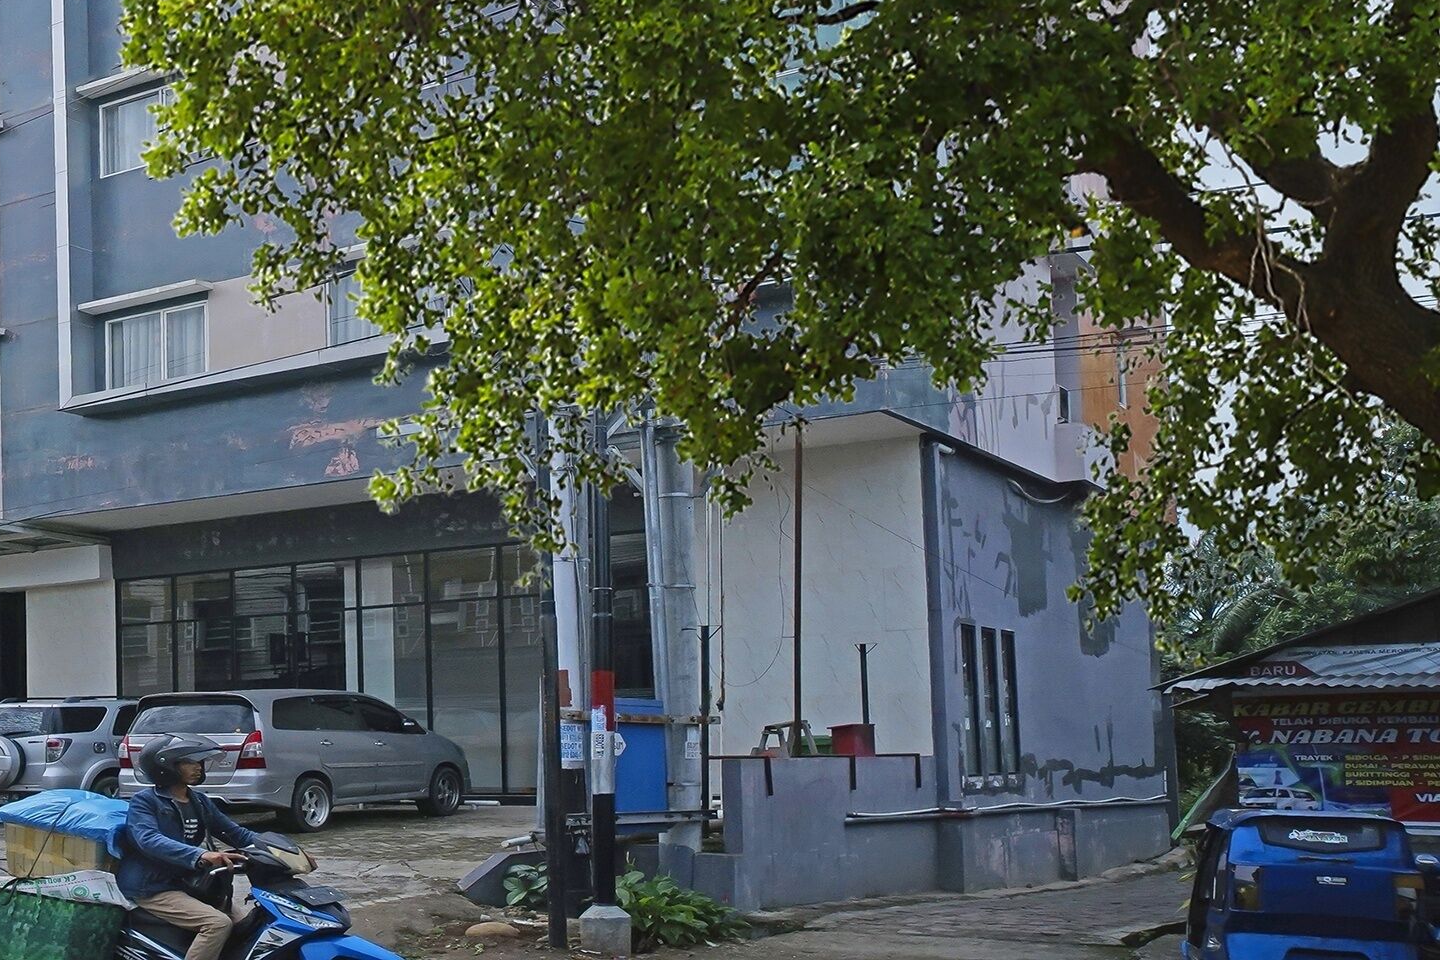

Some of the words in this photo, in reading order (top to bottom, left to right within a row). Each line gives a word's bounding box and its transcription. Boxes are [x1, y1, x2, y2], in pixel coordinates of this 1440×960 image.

[1250, 665, 1297, 677] BARU
[1233, 701, 1331, 717] KABAR
[1272, 718, 1313, 726] TELAH
[1319, 717, 1371, 726] DIBUKA
[1377, 716, 1440, 725] KEMBALI
[1269, 727, 1399, 744] NABANA
[1345, 779, 1414, 787] P.SIDIMPUAN
